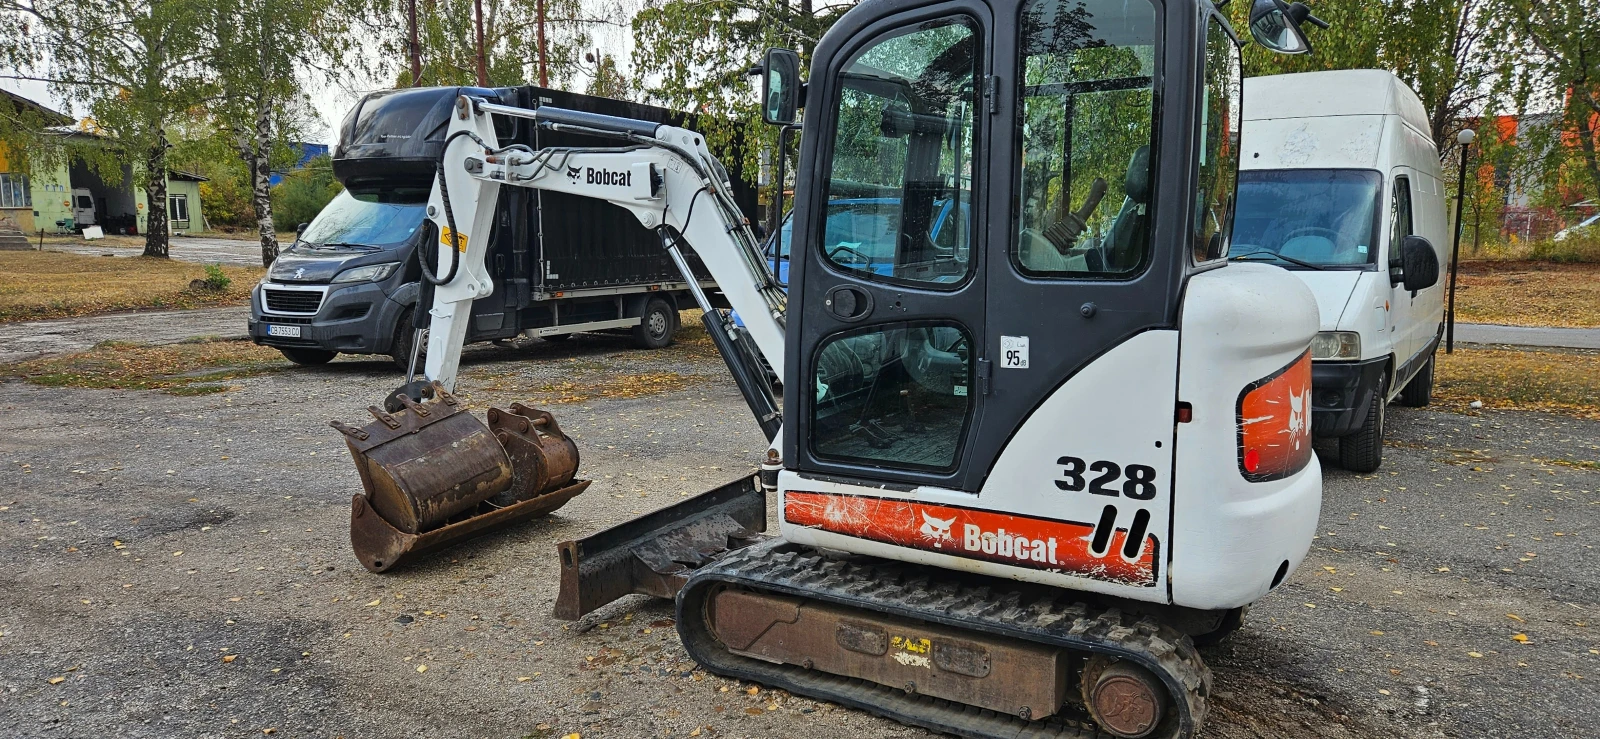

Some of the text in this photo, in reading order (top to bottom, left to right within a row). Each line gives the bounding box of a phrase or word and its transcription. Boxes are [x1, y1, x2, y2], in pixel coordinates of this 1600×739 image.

[586, 167, 632, 187] Bobcat
[1006, 350, 1020, 366] 95
[1054, 455, 1157, 500] 328
[964, 523, 1058, 565] Bobcat
